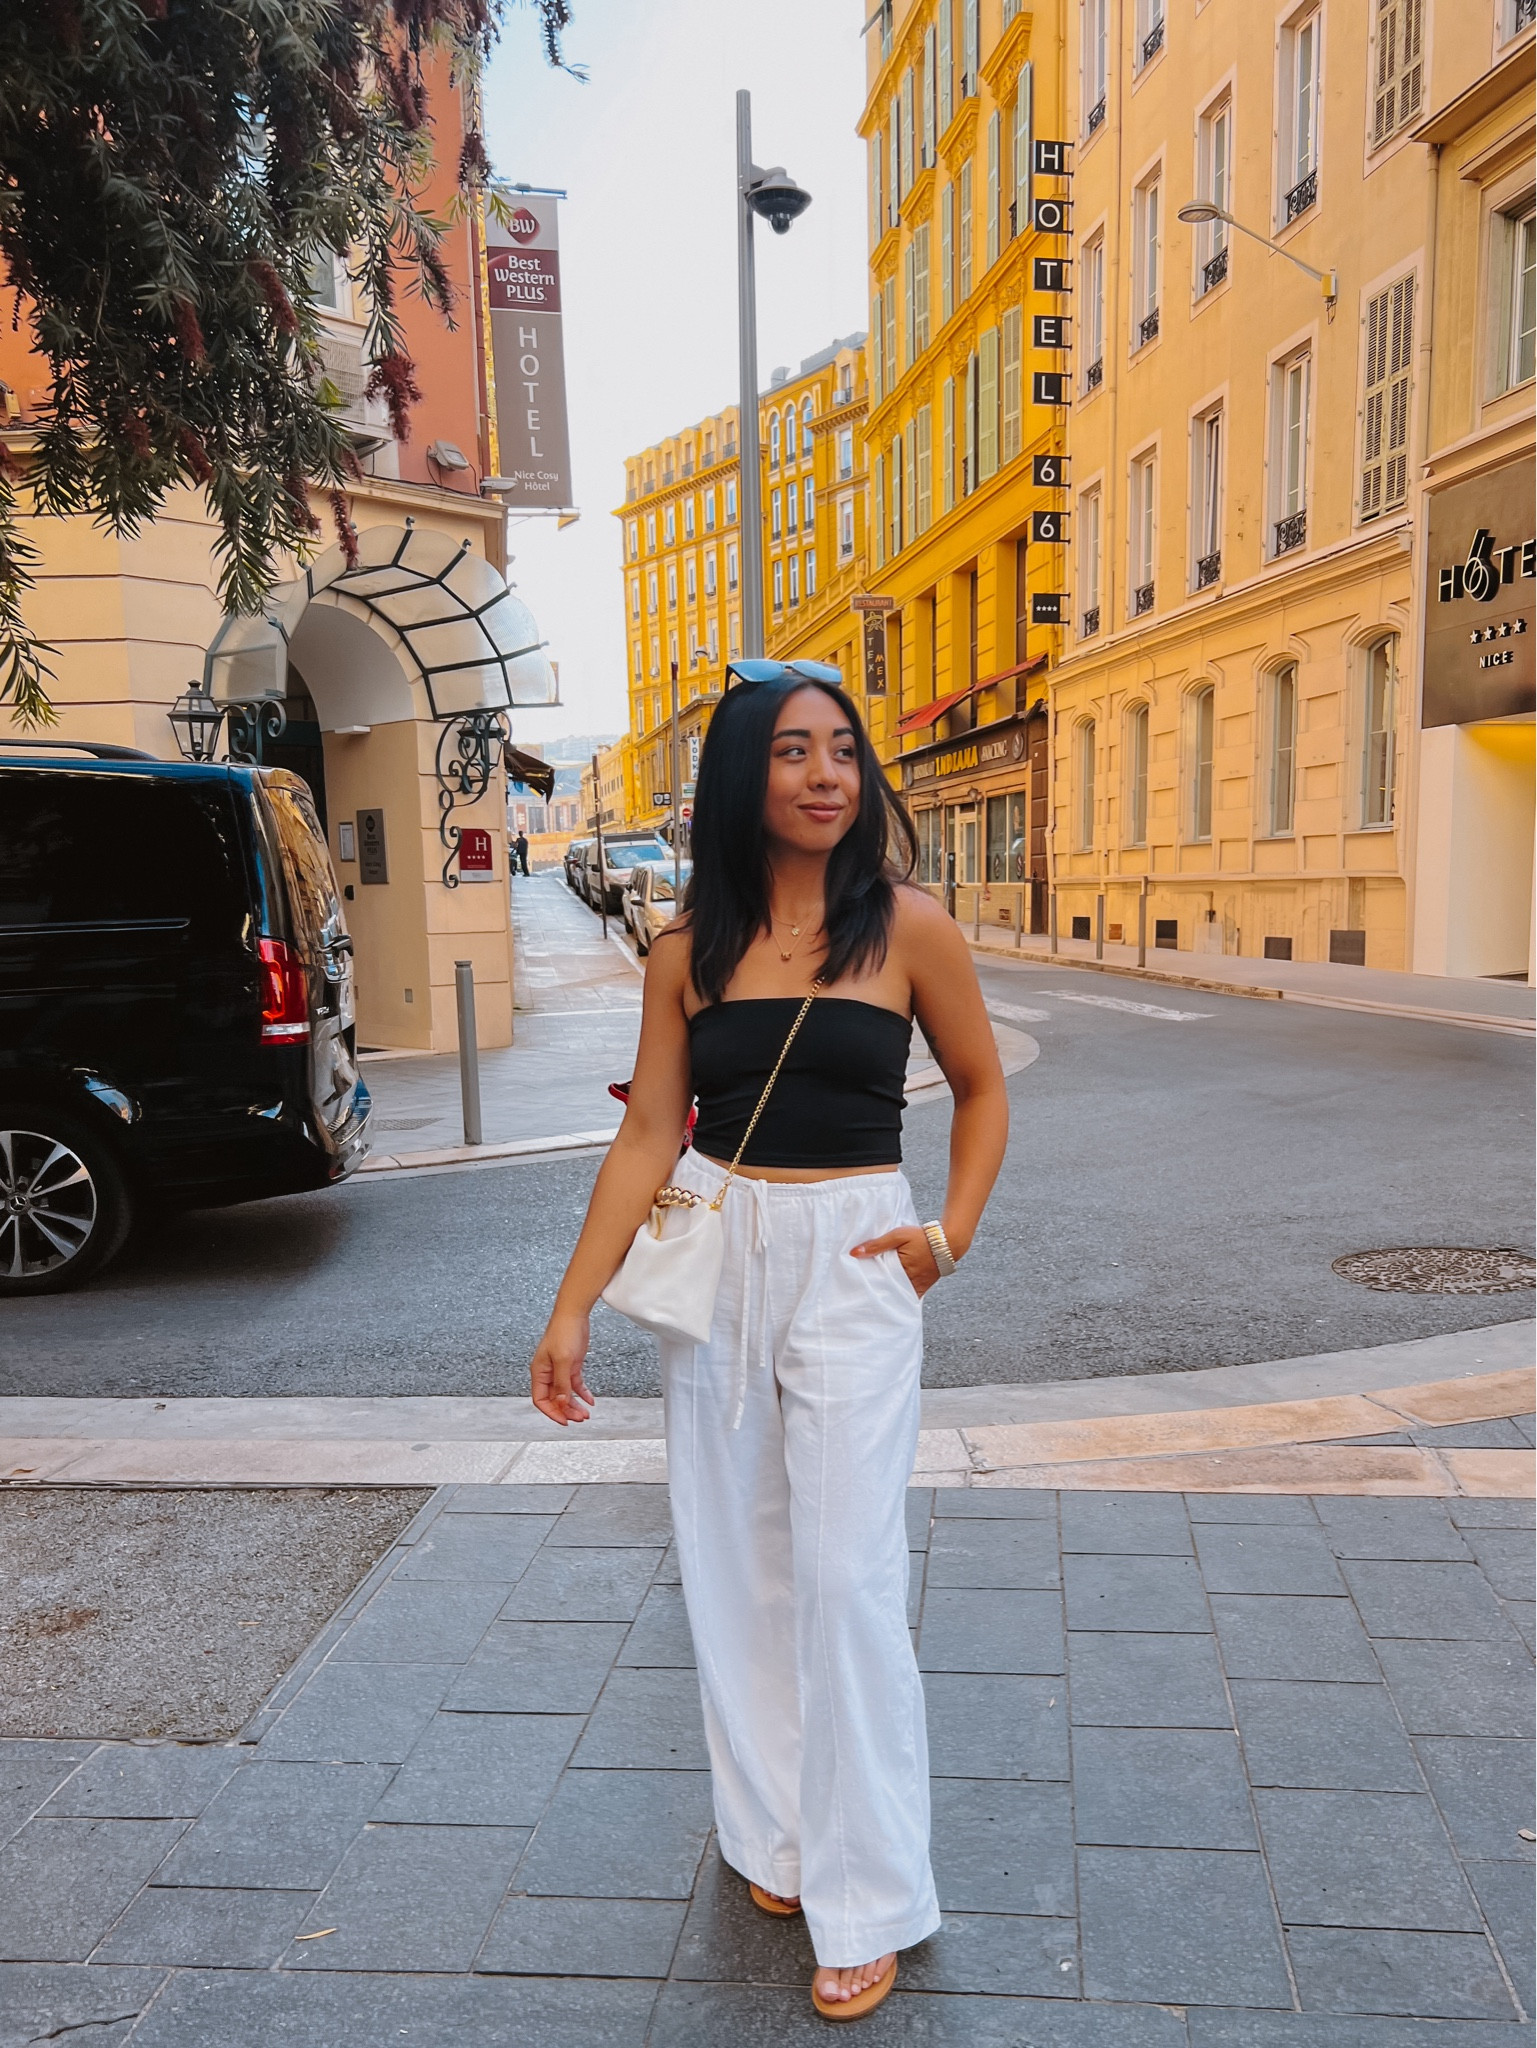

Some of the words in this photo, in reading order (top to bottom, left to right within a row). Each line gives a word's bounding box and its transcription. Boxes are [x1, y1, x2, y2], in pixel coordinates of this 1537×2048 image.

[509, 218, 536, 234] BW
[508, 255, 542, 271] Best
[1038, 143, 1061, 400] HOTEL
[494, 268, 556, 286] Western
[506, 284, 546, 301] PLUS
[518, 326, 544, 458] HOTEL
[514, 470, 535, 480] Nice
[536, 471, 559, 483] Cosy
[524, 480, 551, 491] Hôtel
[1039, 458, 1056, 538] 66
[866, 637, 875, 674] TEX
[1479, 650, 1510, 669] NICE
[874, 653, 885, 690] MEX
[475, 836, 488, 852] H
